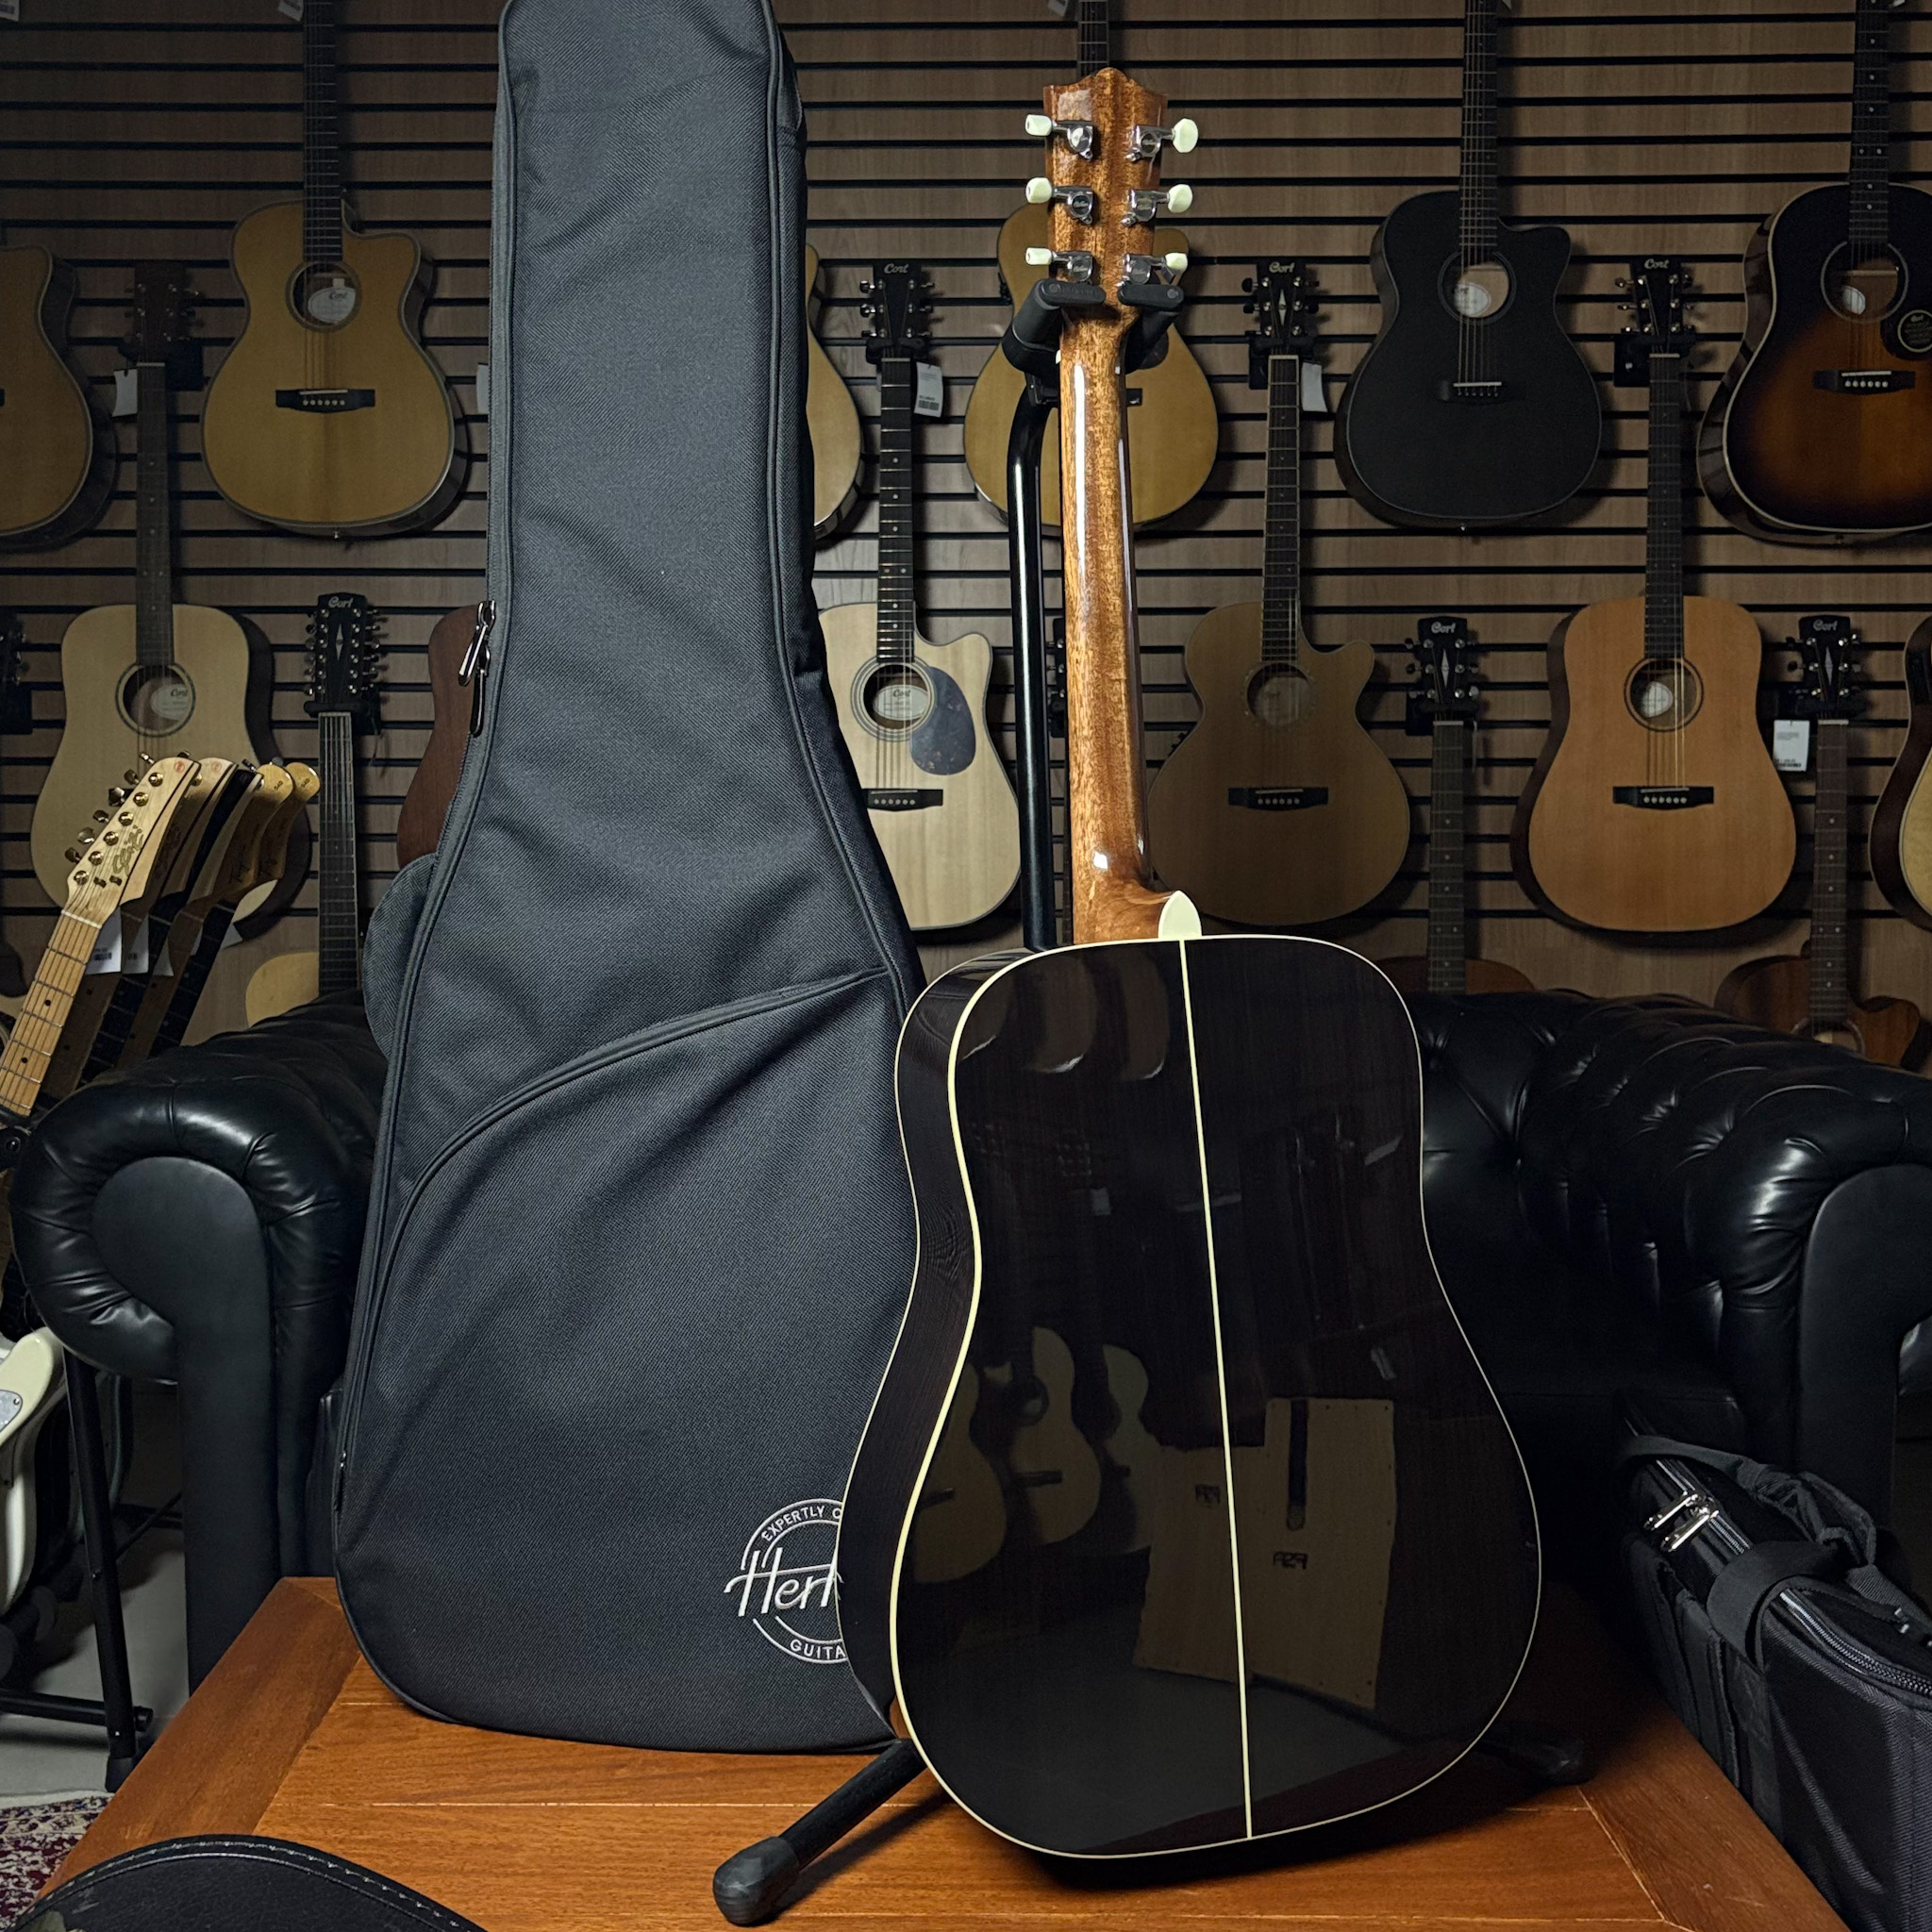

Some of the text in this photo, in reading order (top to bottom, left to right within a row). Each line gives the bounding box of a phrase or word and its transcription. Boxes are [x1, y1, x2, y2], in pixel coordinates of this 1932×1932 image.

[884, 263, 909, 274] Cort
[1269, 261, 1295, 273] Cort
[1644, 258, 1670, 269] Cort
[328, 595, 354, 608] Cort
[1431, 622, 1457, 633] Cort
[1813, 619, 1838, 631] Cort
[761, 1505, 825, 1541] EXPERTLY
[790, 1639, 846, 1659] GUITA
